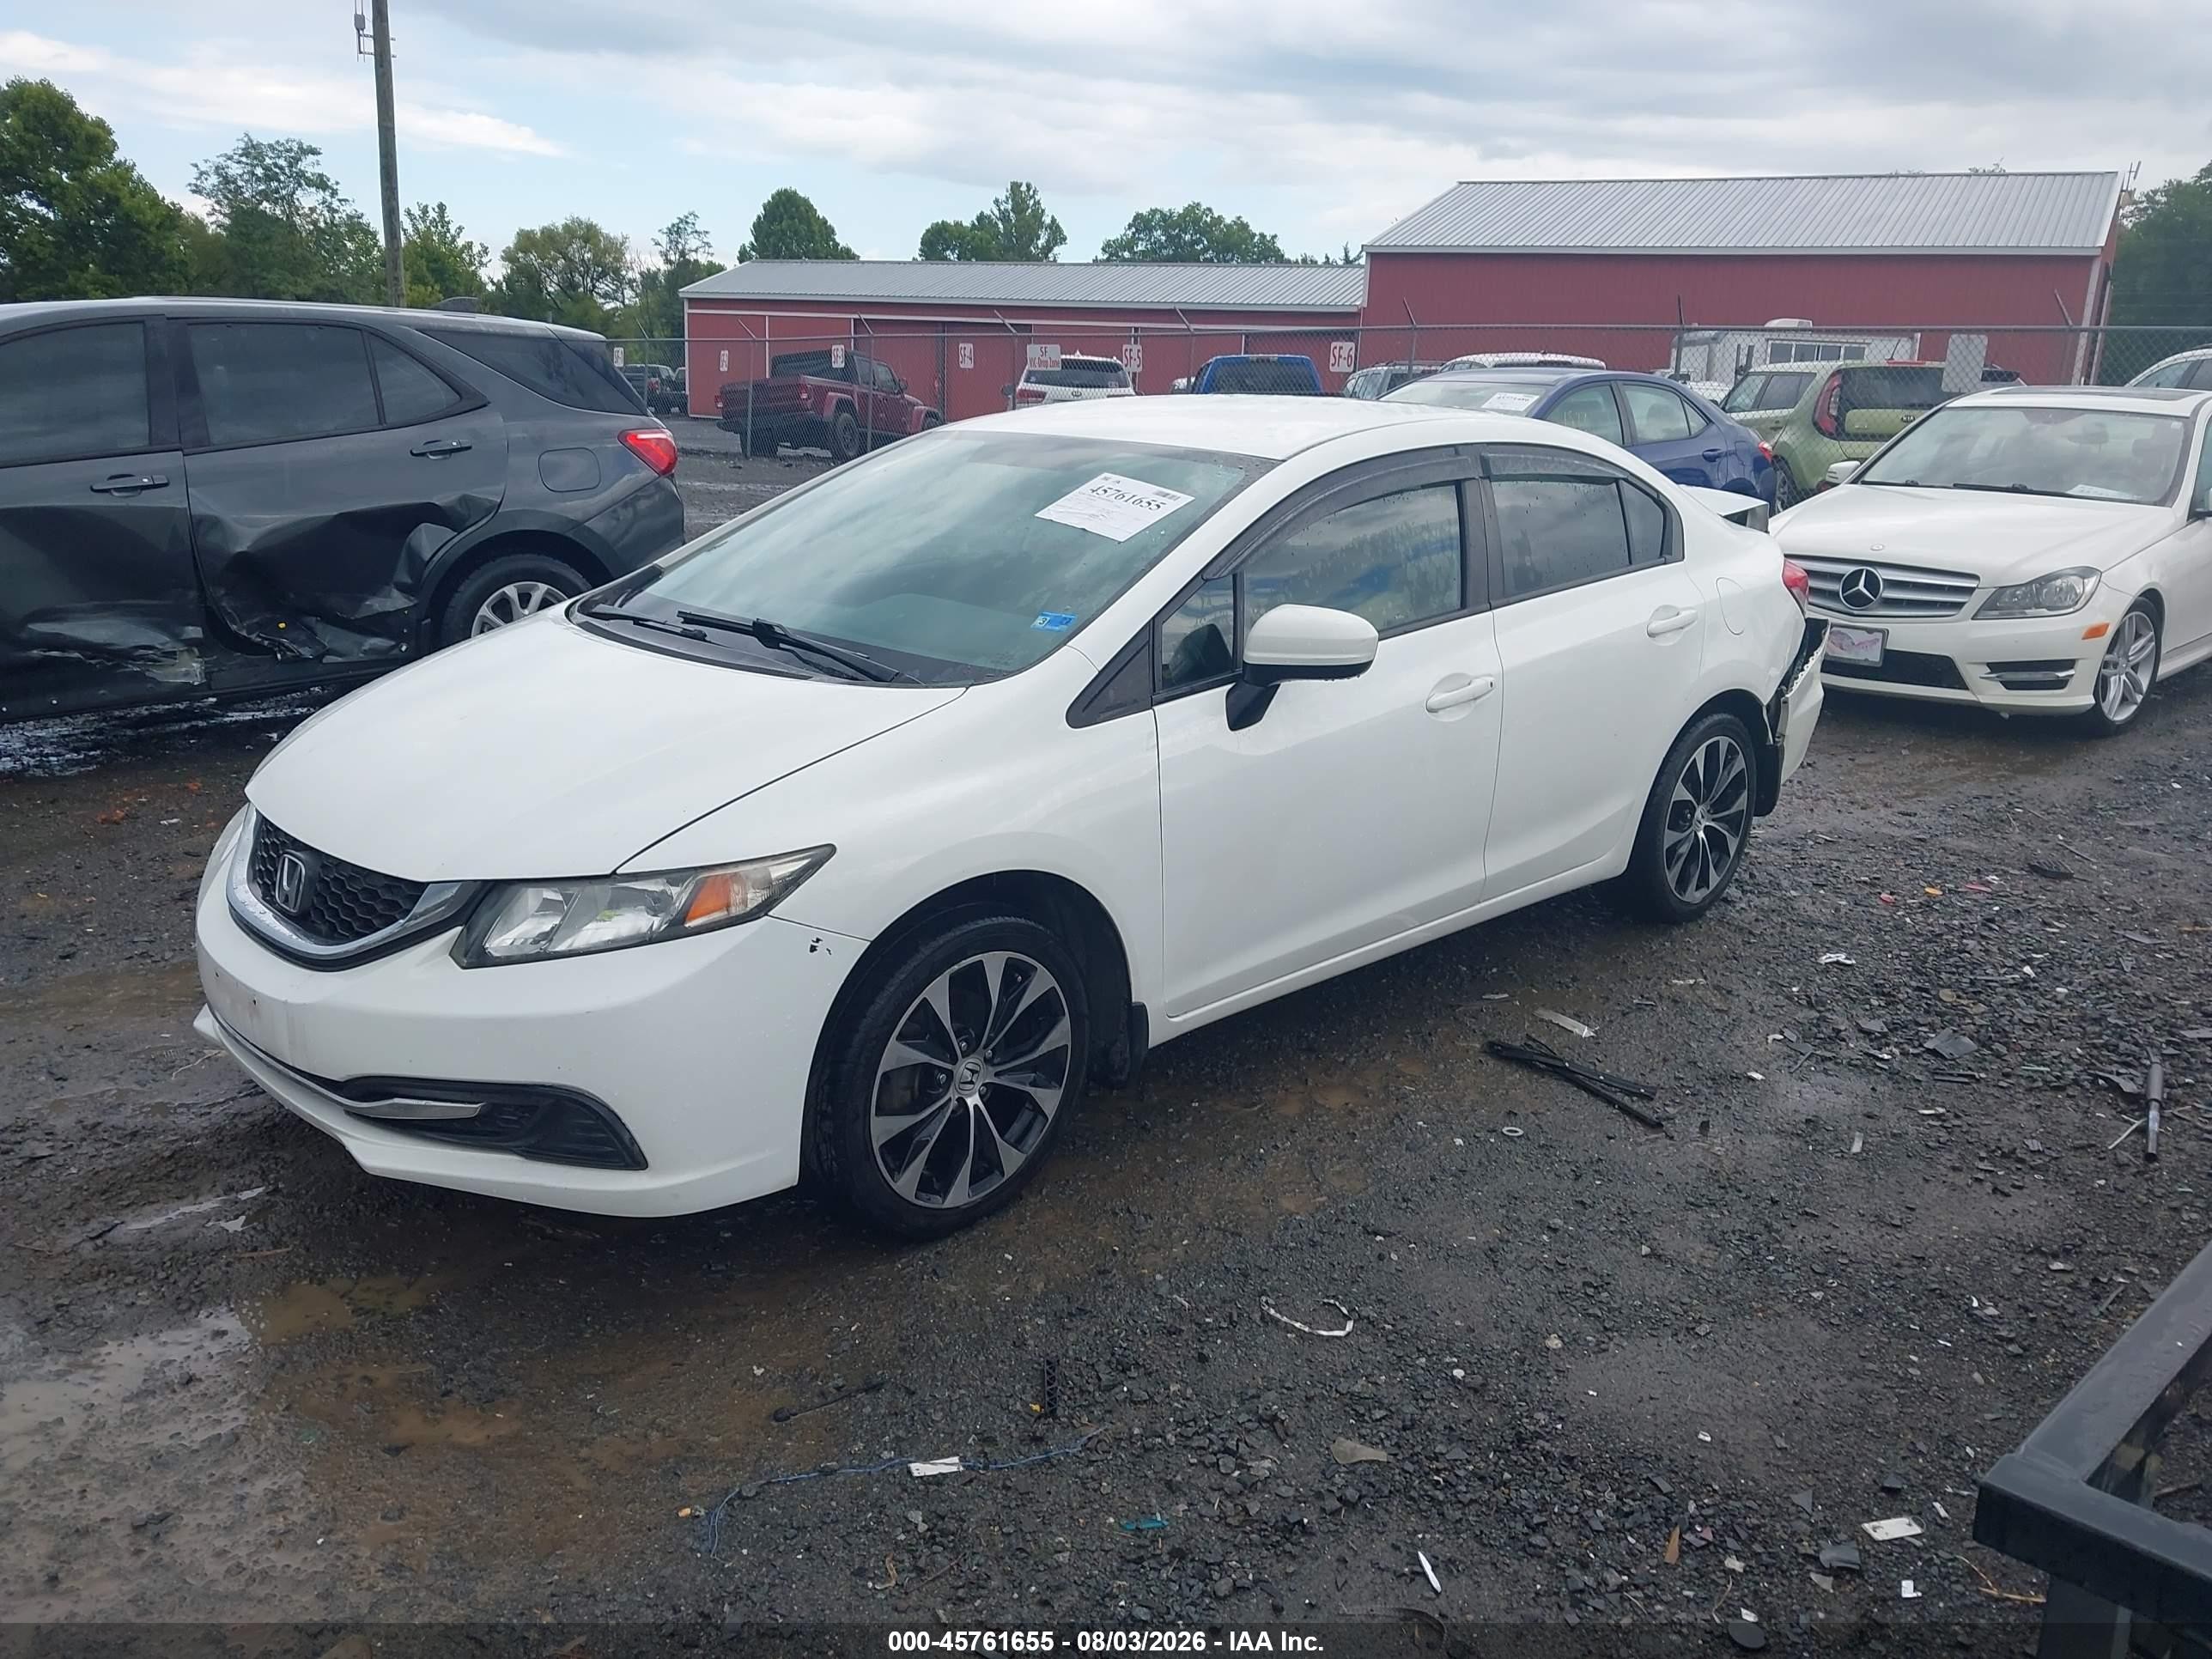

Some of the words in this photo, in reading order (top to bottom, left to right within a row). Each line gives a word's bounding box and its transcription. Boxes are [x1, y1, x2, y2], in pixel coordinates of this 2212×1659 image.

[833, 348, 844, 364] SF-3
[960, 346, 973, 365] SF-4
[1040, 346, 1048, 358] SF
[1124, 349, 1141, 368] SF-5
[1331, 346, 1353, 368] SF-6
[1090, 485, 1166, 511] 45761655
